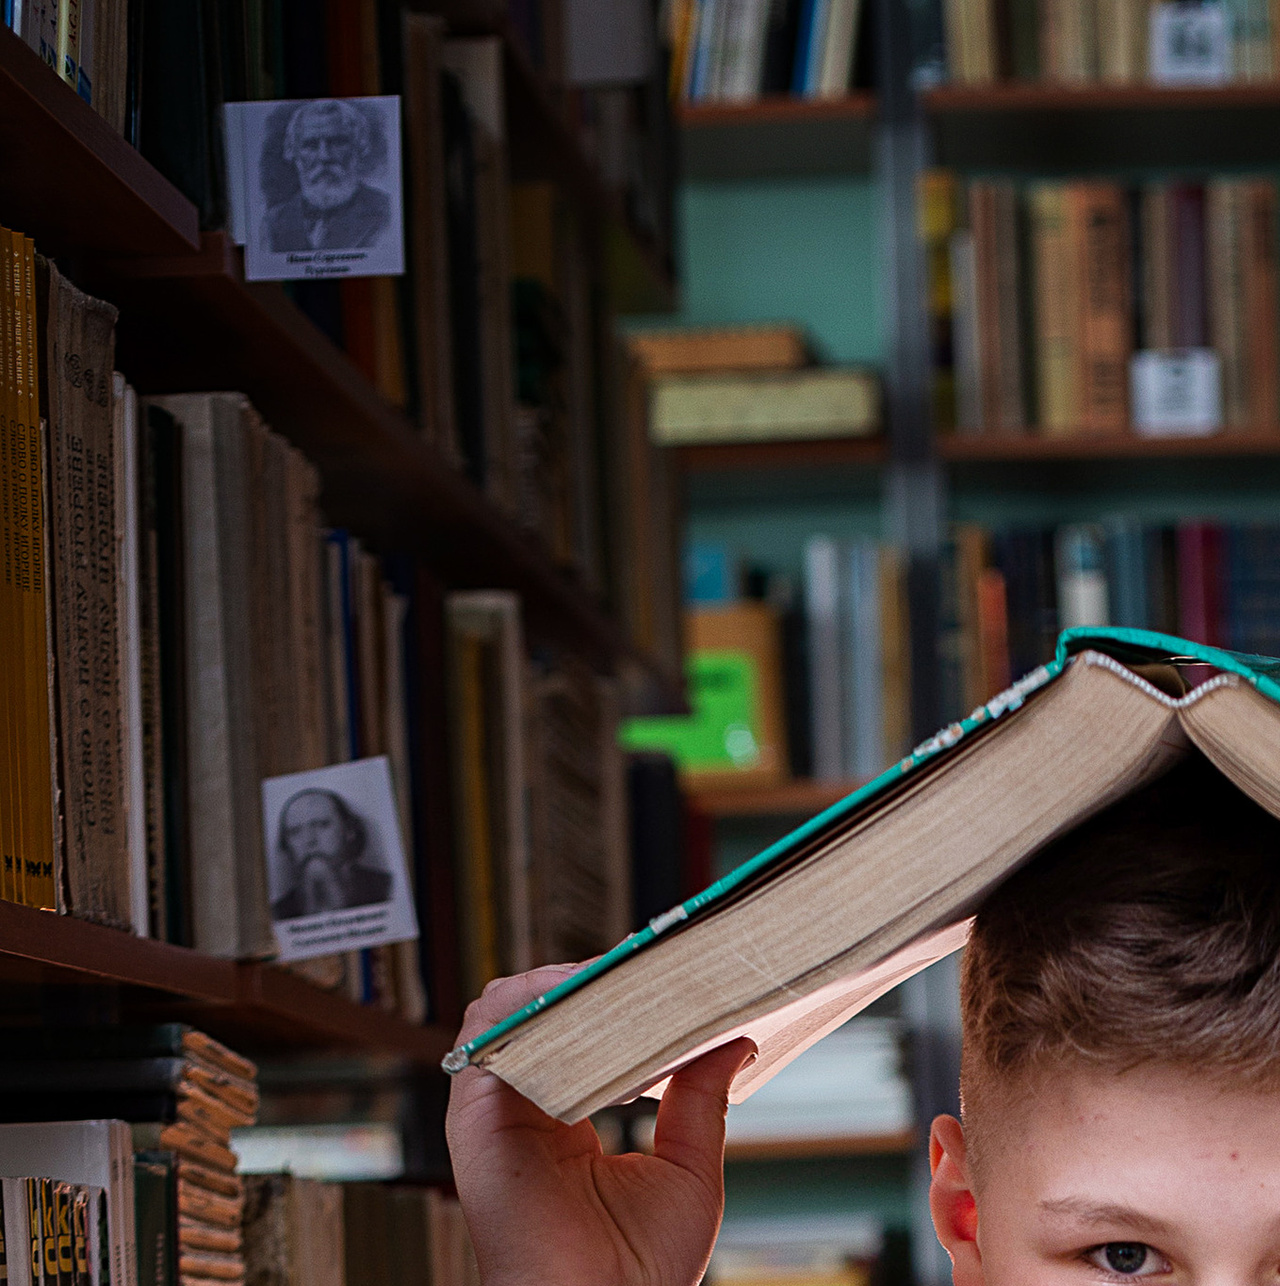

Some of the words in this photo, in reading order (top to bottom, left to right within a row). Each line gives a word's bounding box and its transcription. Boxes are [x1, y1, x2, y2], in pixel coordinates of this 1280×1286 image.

[17, 423, 26, 469] СЛОВО
[29, 425, 38, 472] СЛОВО
[19, 486, 28, 532] ПОЛКУ
[31, 489, 40, 534] ПОЛКУ
[71, 435, 87, 571] ИГОРЕВЕ
[21, 535, 30, 592] ИГОРЕВЕ
[33, 537, 42, 594] ИГОРЕВЕ
